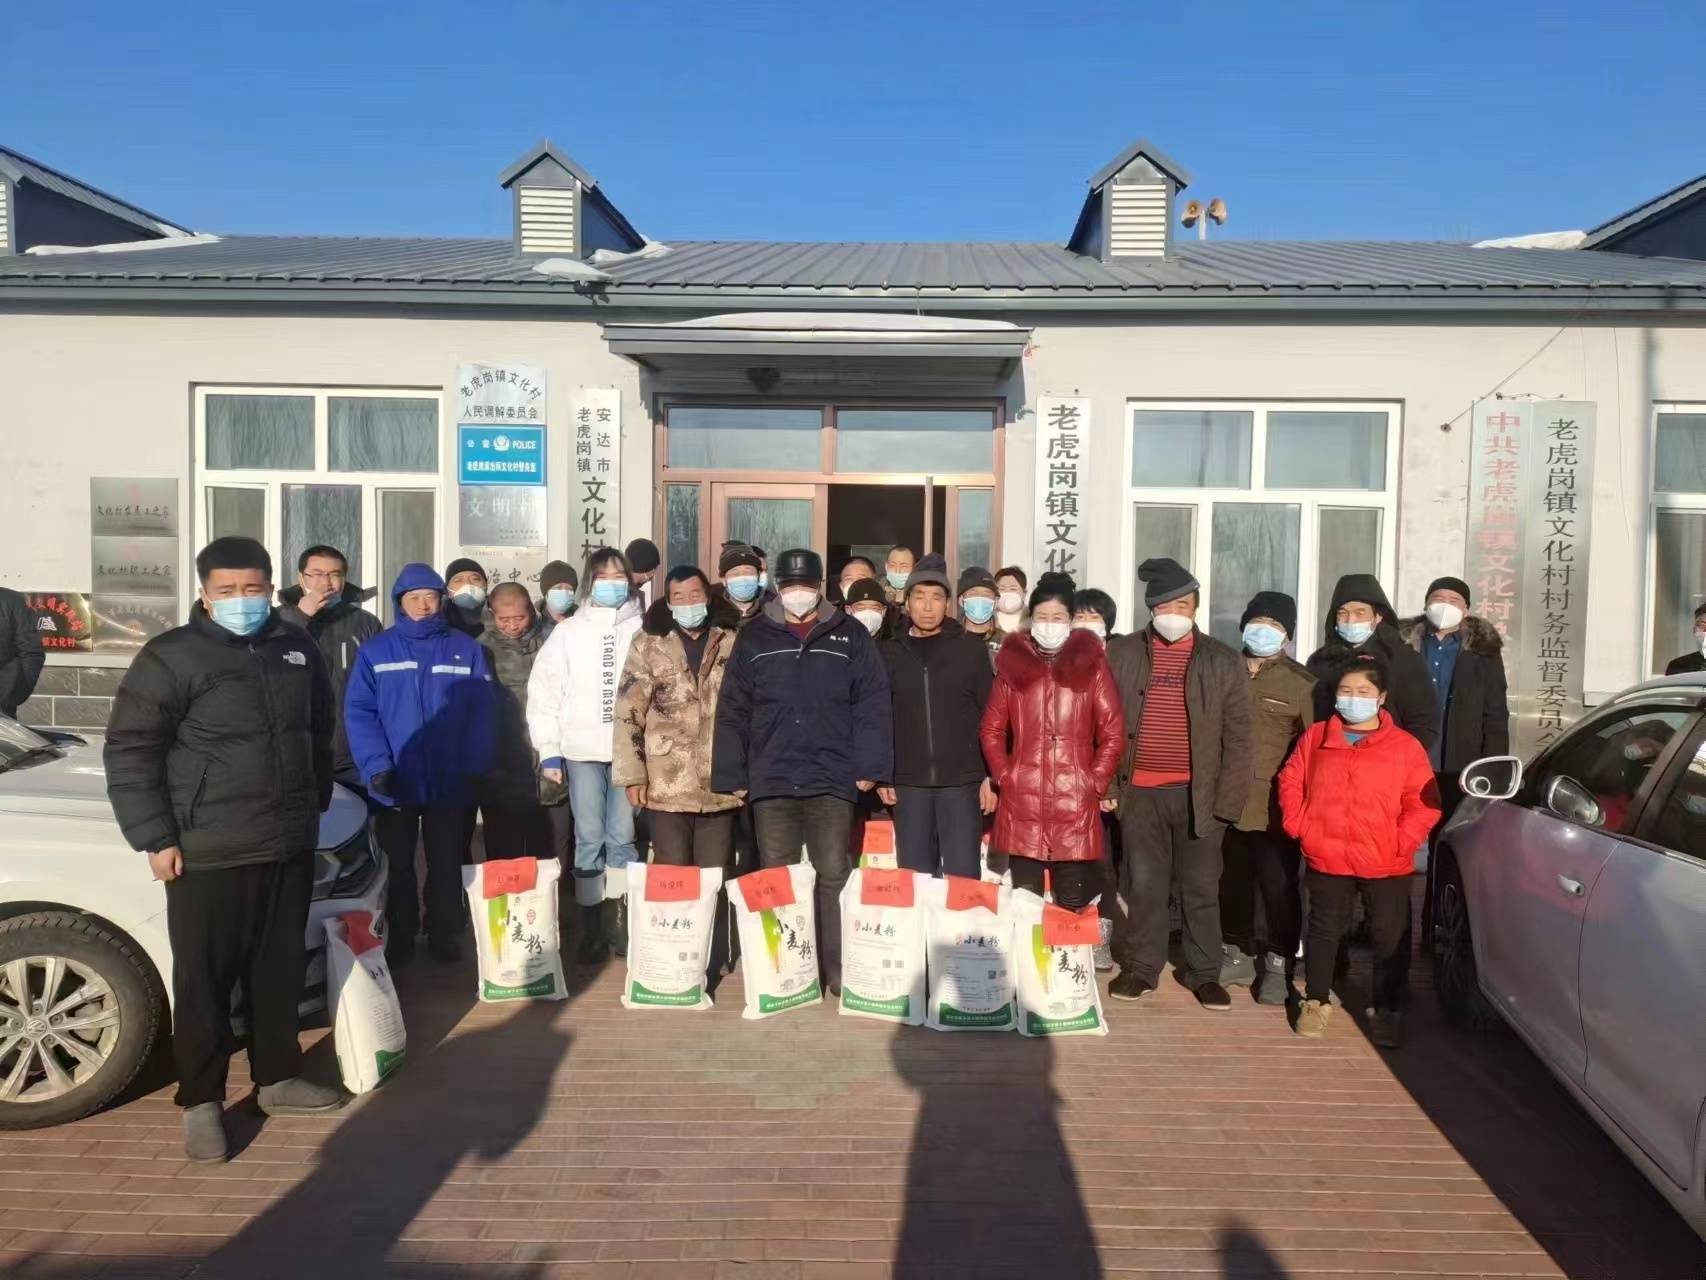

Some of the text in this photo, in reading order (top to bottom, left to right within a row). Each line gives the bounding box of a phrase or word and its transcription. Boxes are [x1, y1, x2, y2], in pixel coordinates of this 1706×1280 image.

[461, 369, 542, 400] 老虎岗镇文化村
[463, 405, 537, 419] 人民调解委员会
[512, 440, 536, 449] POLICE
[576, 407, 592, 473] 老虎岗镇
[602, 634, 615, 667] STAND
[602, 671, 614, 685] BY
